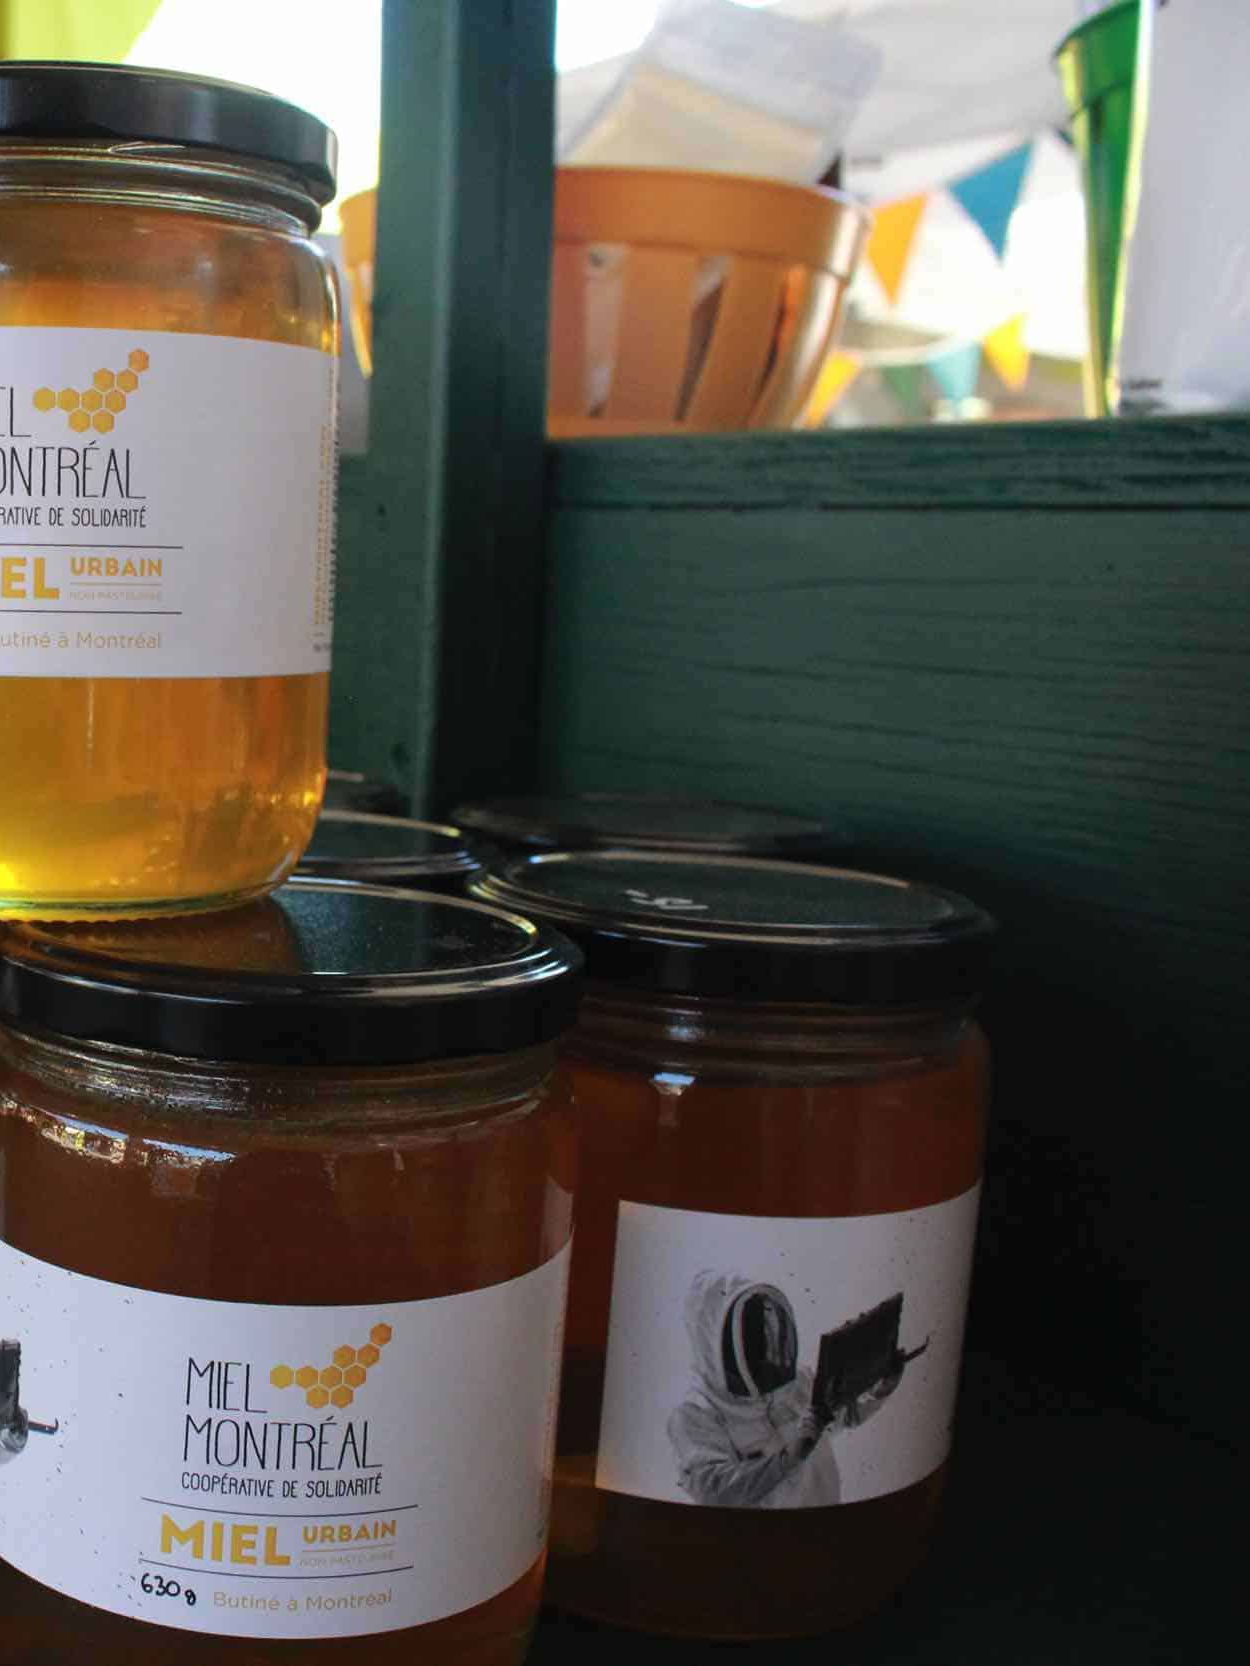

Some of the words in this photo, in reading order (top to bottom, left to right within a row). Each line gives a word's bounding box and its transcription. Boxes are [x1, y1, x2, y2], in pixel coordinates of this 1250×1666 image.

[49, 506, 64, 527] DE
[71, 505, 147, 528] SOLIDARITÉ
[70, 557, 162, 577] URBAIN
[57, 632, 69, 648] à
[77, 630, 161, 649] Montréal
[186, 1357, 268, 1413] MIEL
[184, 1414, 382, 1471] MONTRÉAL
[181, 1471, 274, 1498] COOPÉRATIVE
[282, 1480, 298, 1499] DE
[305, 1472, 383, 1498] SOLIDARITÉ
[159, 1512, 292, 1566] MIEL
[302, 1519, 396, 1544] URBAIN
[141, 1572, 181, 1597] 630
[213, 1591, 281, 1611] Butiné
[286, 1595, 299, 1612] à
[306, 1588, 393, 1612] Montréal
